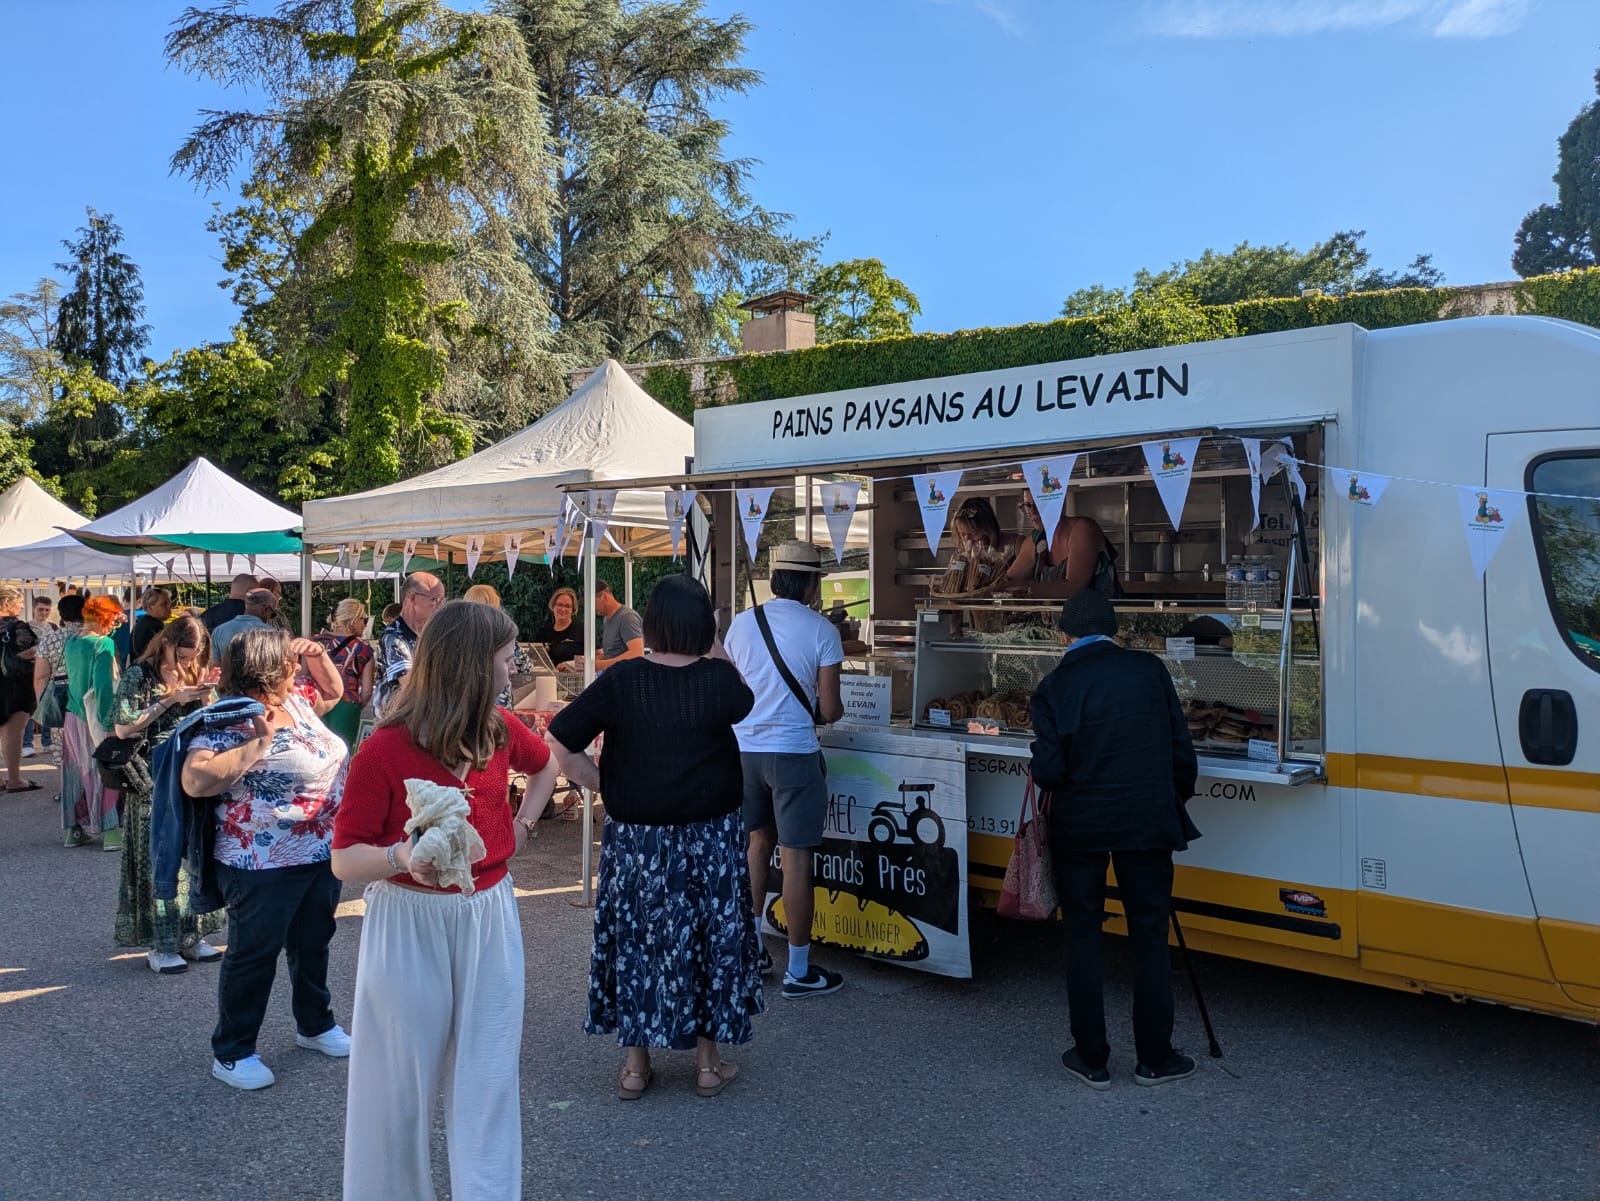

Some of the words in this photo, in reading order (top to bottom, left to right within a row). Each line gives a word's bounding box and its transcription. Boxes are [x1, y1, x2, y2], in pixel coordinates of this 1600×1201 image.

[771, 406, 834, 440] PAINS
[842, 391, 965, 433] PAYSANS
[972, 383, 1023, 420] AU
[1036, 362, 1190, 412] LEVAIN
[847, 700, 876, 710] LEVAIN
[824, 794, 857, 835] AEC
[813, 850, 864, 886] rands
[878, 856, 926, 896] Prés
[1293, 893, 1314, 904] MP
[813, 911, 826, 930] AN
[835, 914, 901, 945] BOULANGER
